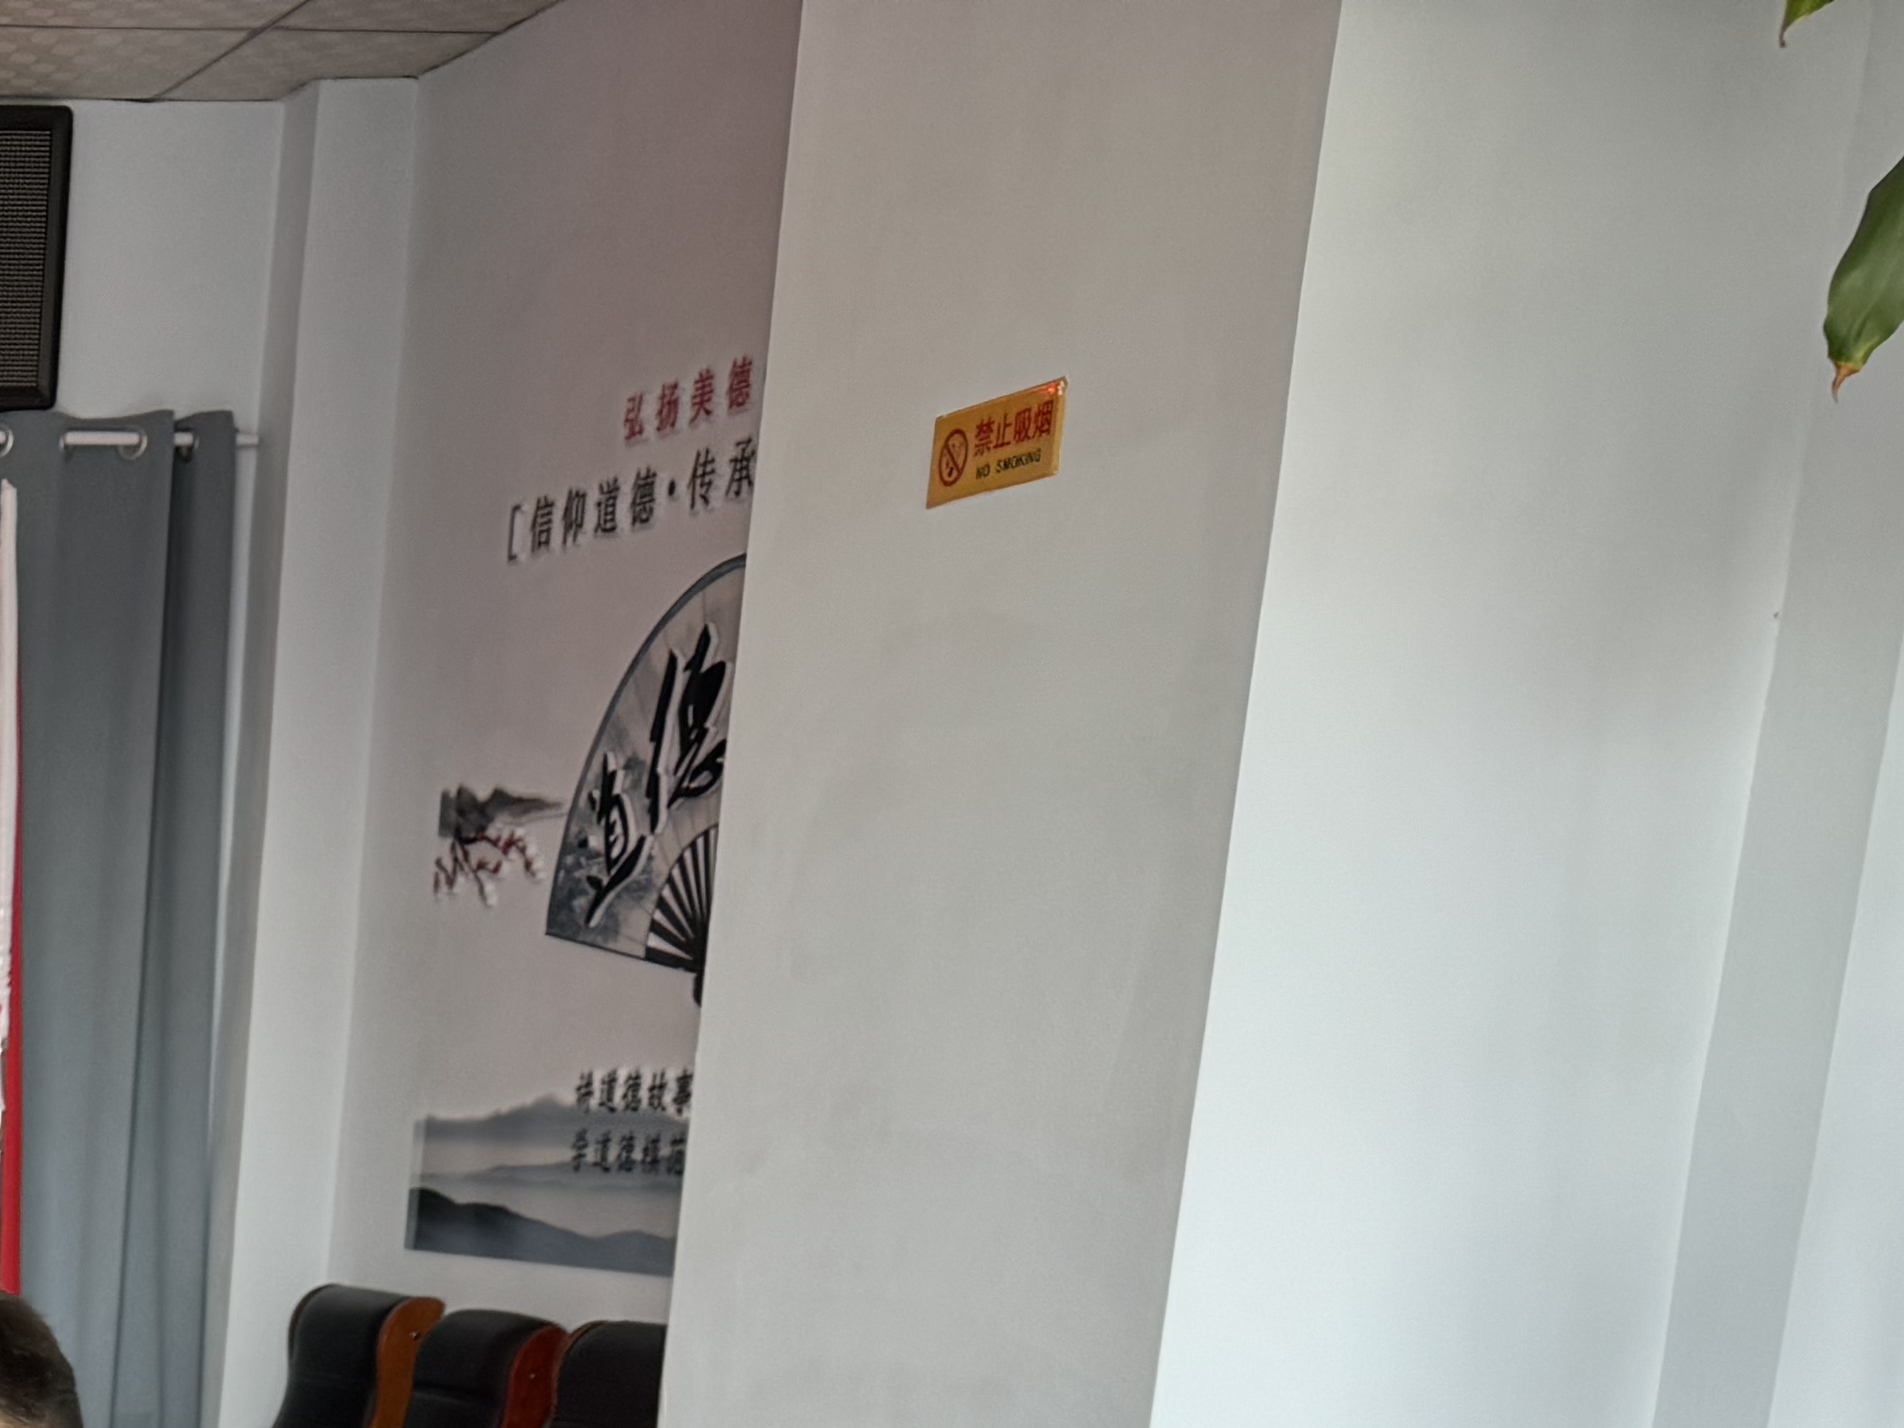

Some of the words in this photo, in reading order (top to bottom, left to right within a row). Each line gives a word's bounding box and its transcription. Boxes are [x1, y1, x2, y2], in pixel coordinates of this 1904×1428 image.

[623, 354, 753, 441] 弘扬美德
[973, 400, 1054, 457] 禁止吸烟
[976, 464, 990, 480] NO
[996, 448, 1041, 473] SMOKING
